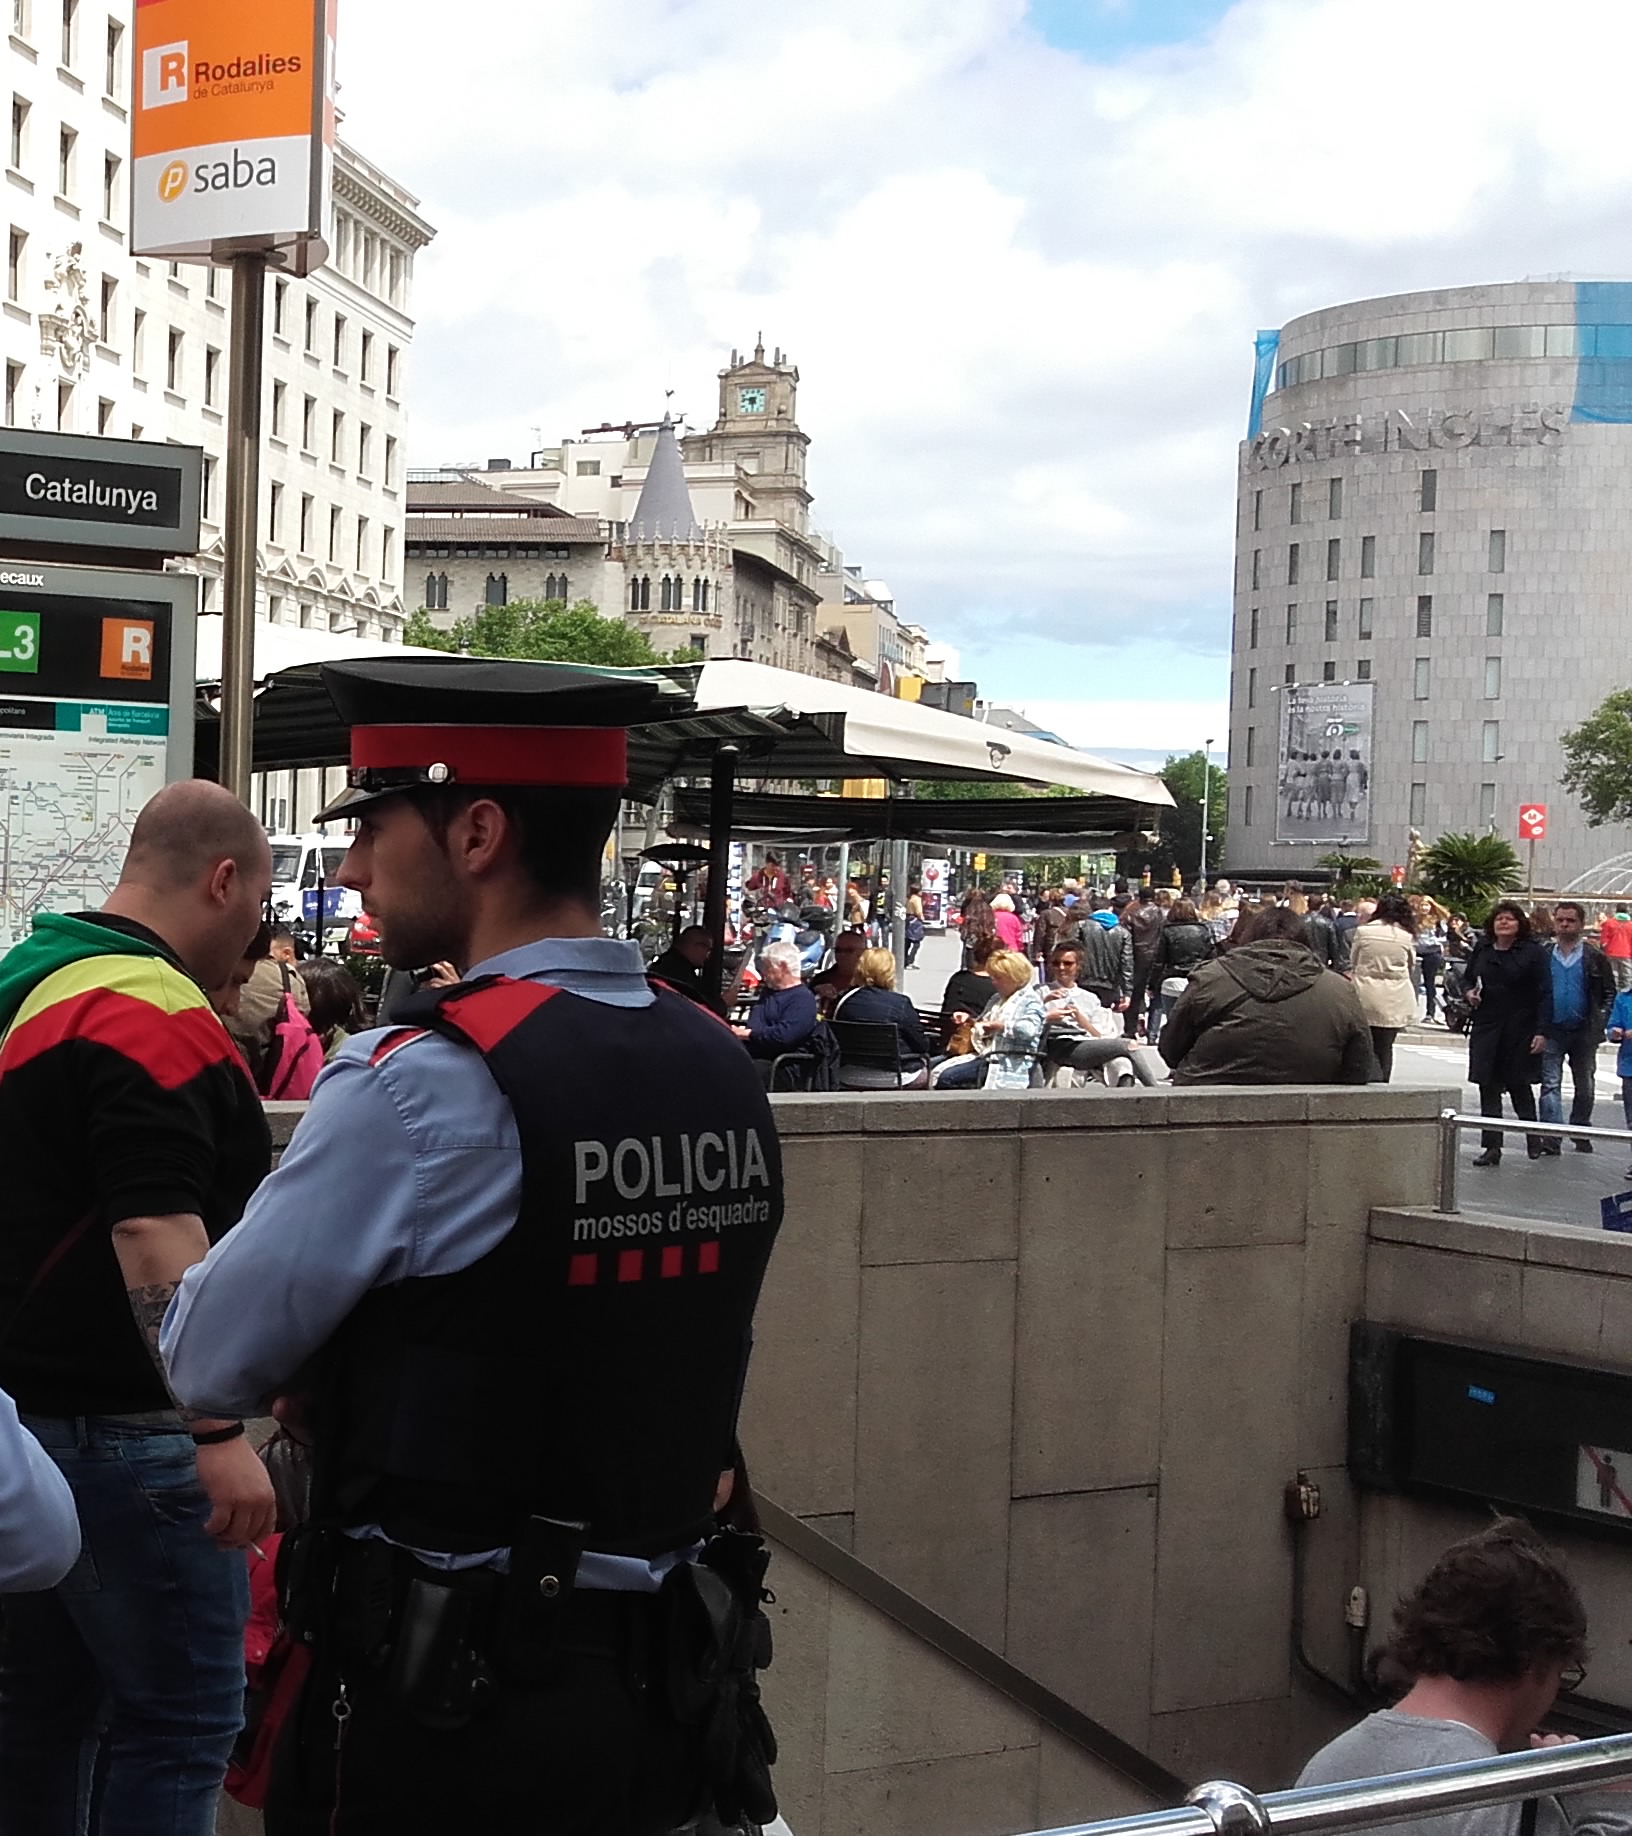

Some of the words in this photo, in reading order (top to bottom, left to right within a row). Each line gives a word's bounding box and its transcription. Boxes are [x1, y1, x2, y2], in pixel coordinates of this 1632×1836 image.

[194, 54, 302, 84] Rodalies
[193, 87, 208, 99] de
[211, 79, 275, 97] Catalunya
[194, 148, 277, 193] saba
[25, 473, 159, 514] Catalunya
[121, 627, 151, 664] R
[88, 707, 105, 715] ATM
[574, 1128, 770, 1204] POLICIA
[574, 1211, 663, 1241] mossos
